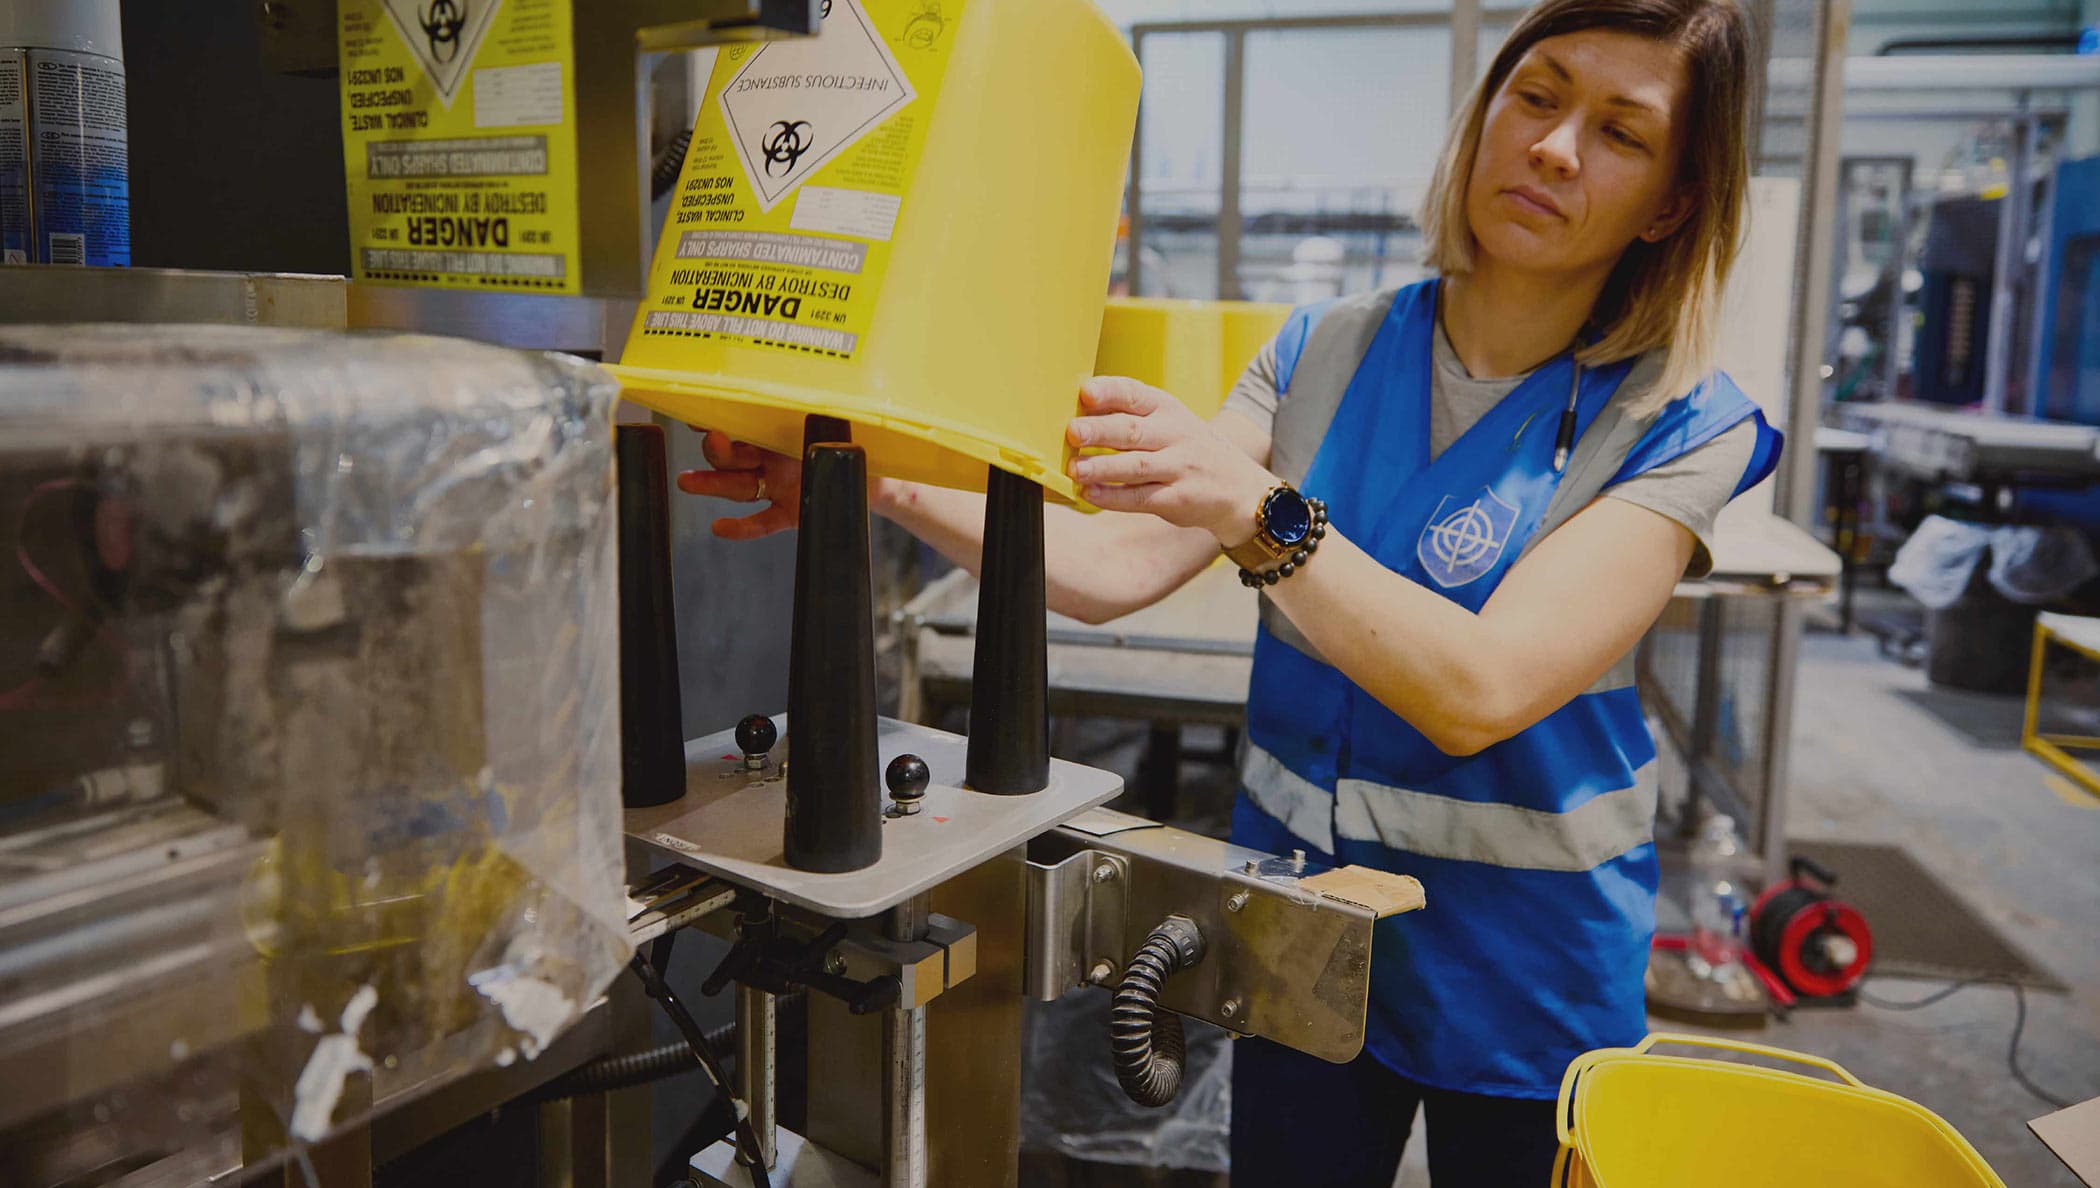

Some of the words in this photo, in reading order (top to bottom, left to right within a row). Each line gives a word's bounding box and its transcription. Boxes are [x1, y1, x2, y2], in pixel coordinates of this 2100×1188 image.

[737, 75, 803, 92] SUBSTANCE
[805, 75, 888, 91] INFECTIOUS
[370, 155, 400, 176] ONLY
[401, 154, 448, 175] SHARPS
[685, 178, 713, 191] UN3291
[715, 177, 734, 188] NOS
[372, 193, 458, 214] INCINERATION
[463, 193, 479, 213] BY
[483, 192, 546, 214] DESTROY
[705, 210, 744, 222] CLINICAL
[407, 217, 508, 247] DANGER
[679, 241, 706, 257] ONLY
[707, 240, 752, 258] SHARPS
[753, 242, 859, 271] CONTAMINATED
[670, 269, 753, 289] INCINERATION
[756, 274, 776, 290] BY
[778, 277, 851, 301] DESTROY
[692, 288, 802, 319] DANGER
[651, 311, 669, 327] LINE
[669, 313, 689, 328] THIS
[689, 315, 721, 332] ABOVE
[810, 309, 832, 321] 3291
[833, 313, 846, 324] UN
[722, 318, 745, 334] FILL
[745, 320, 768, 338] NOT
[769, 324, 785, 338] DO
[787, 326, 844, 350] WARNING
